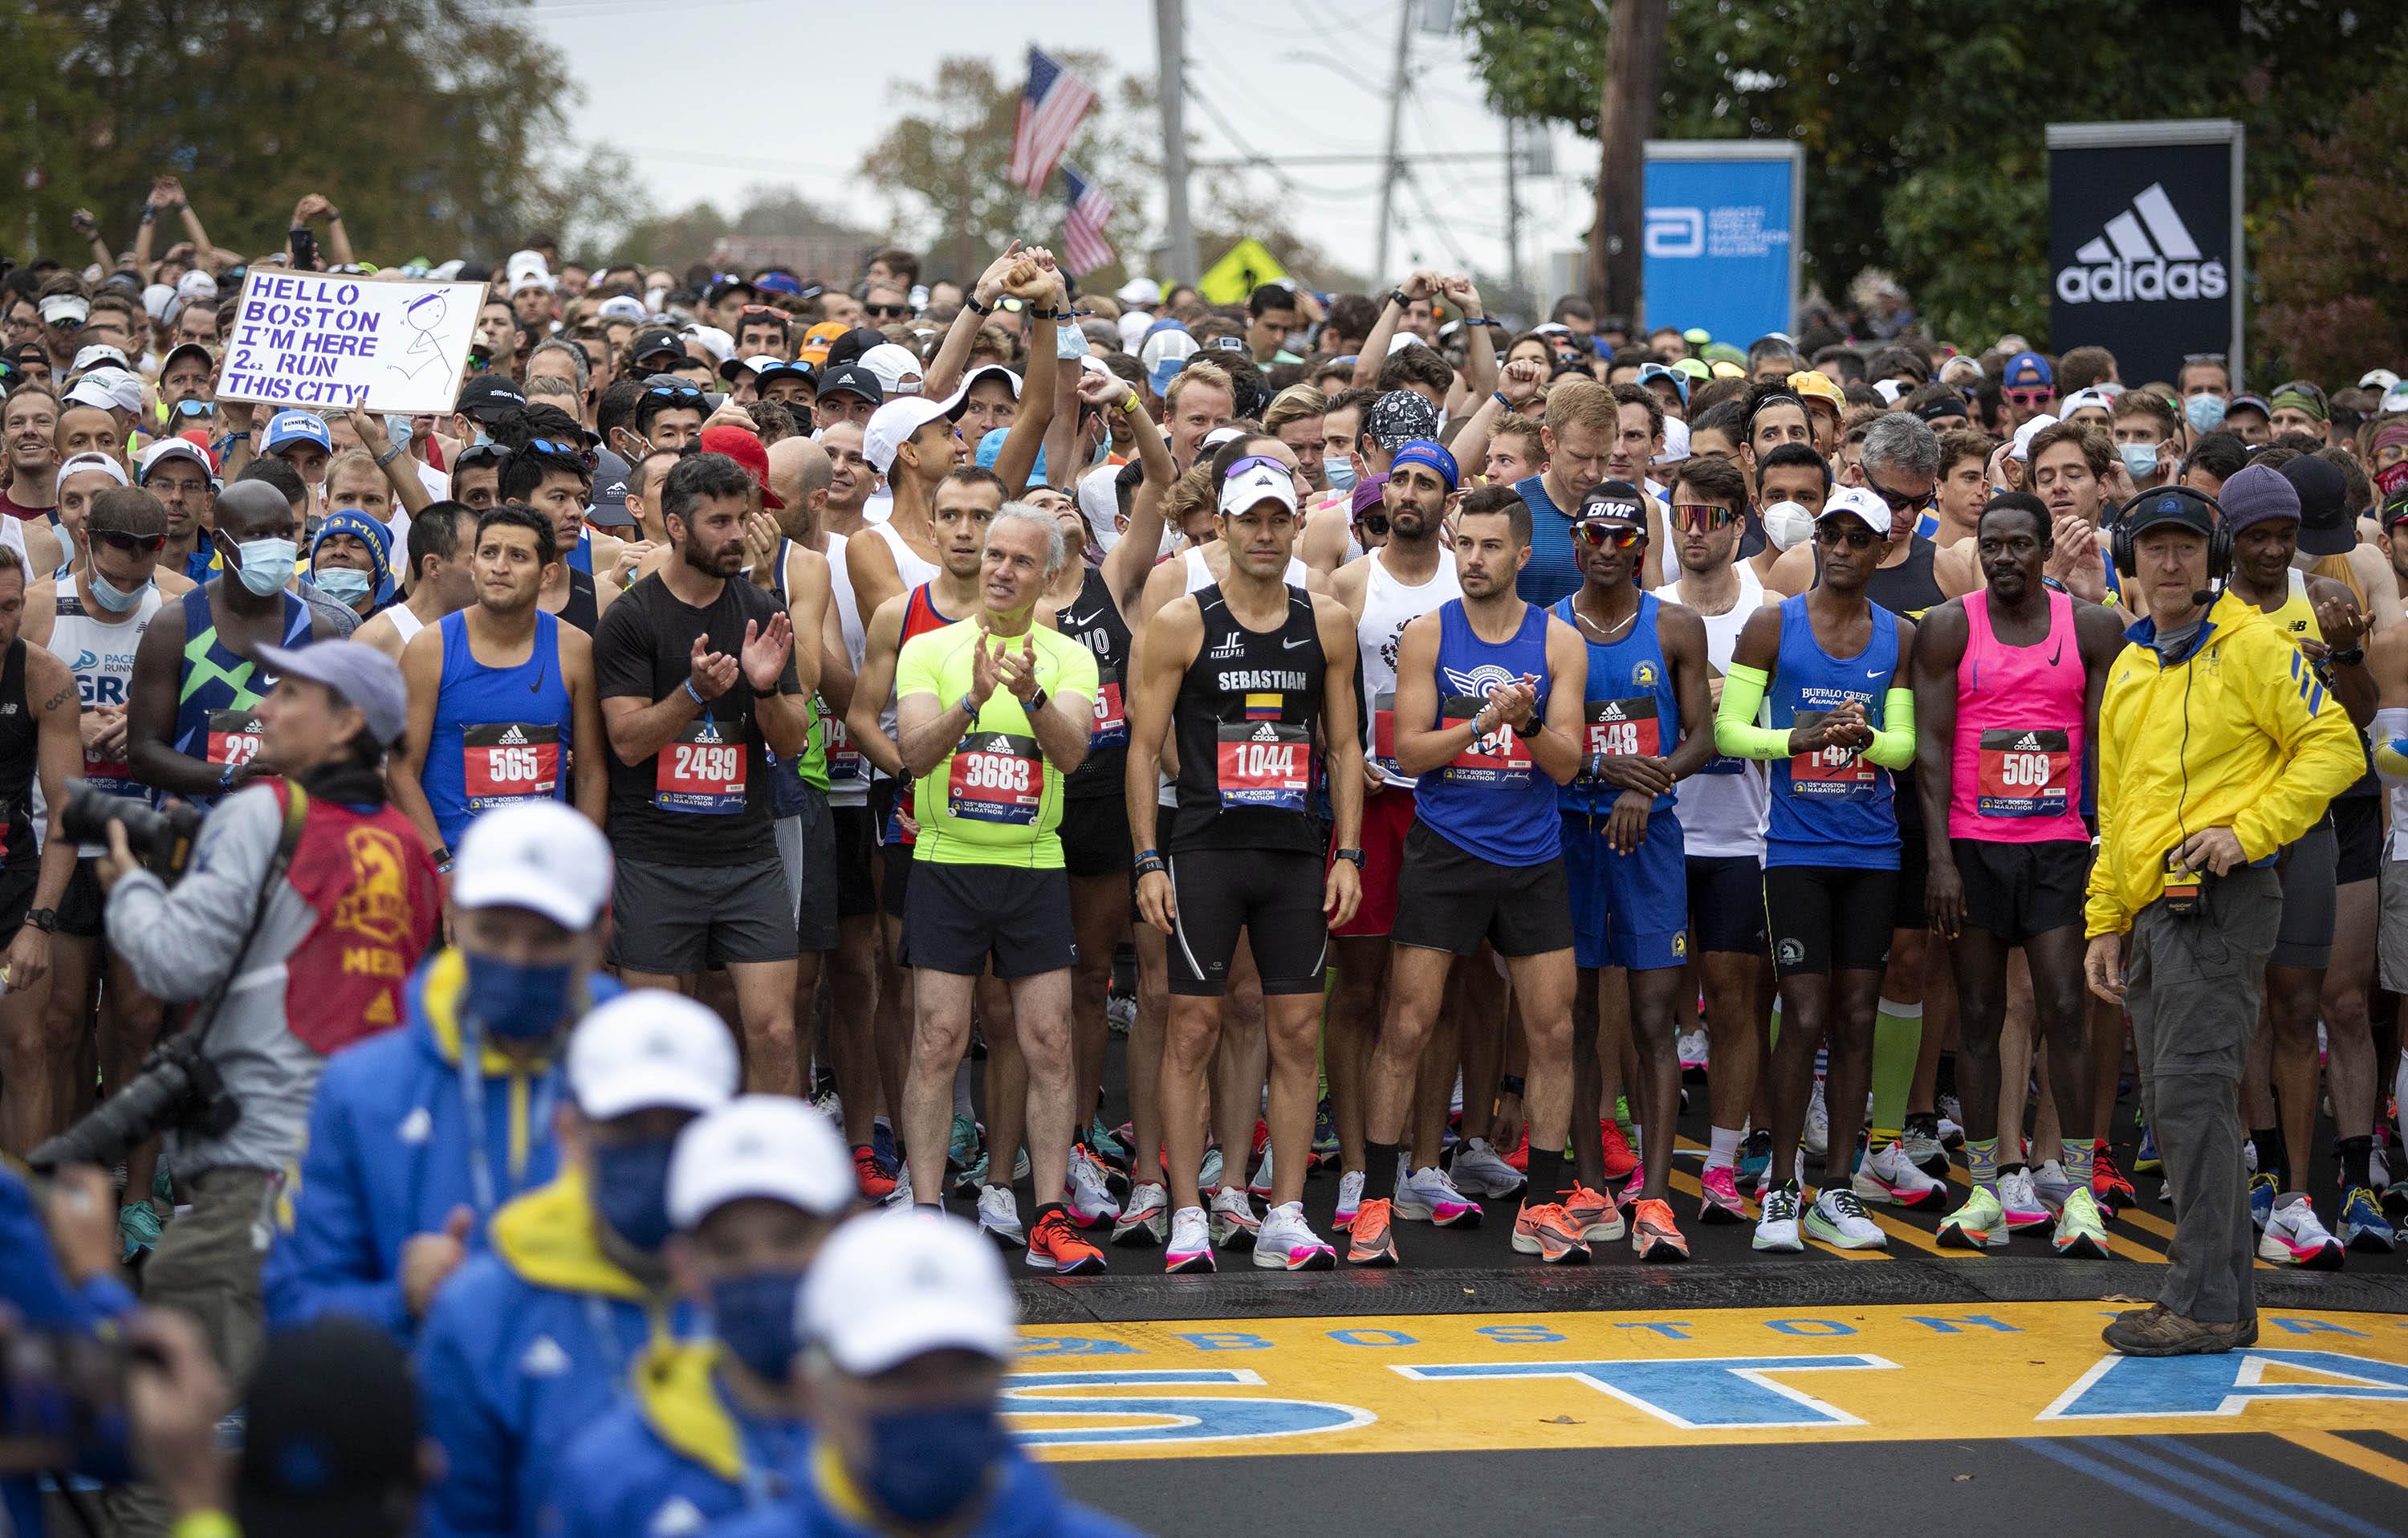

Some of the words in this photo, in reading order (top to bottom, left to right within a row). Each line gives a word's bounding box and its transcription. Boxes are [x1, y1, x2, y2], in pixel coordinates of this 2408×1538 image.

[251, 276, 360, 306] HELLO
[2056, 255, 2228, 303] adidas
[244, 301, 380, 332] BOSTON
[238, 325, 296, 350] I'M
[301, 332, 379, 357] HERE
[276, 352, 339, 377] RUN
[228, 372, 292, 399] THIS
[295, 380, 370, 405] CITY!
[1218, 670, 1306, 690] SEBASTIAN
[1474, 668, 1508, 681] CHARLOTTE
[1802, 688, 1841, 698] BUFFALO
[1843, 690, 1873, 703] CREEK
[1599, 713, 1626, 722] adidas
[986, 746, 1014, 755] adidas
[1590, 723, 1638, 755] 548
[489, 747, 538, 782] 565
[675, 746, 737, 781] 2439
[966, 754, 1029, 791] 3683
[1236, 745, 1294, 777] 1044
[2003, 754, 2049, 786] 509
[1456, 774, 1495, 782] MARATHON
[673, 799, 713, 807] MARATHON
[964, 807, 1003, 816] MARATHON
